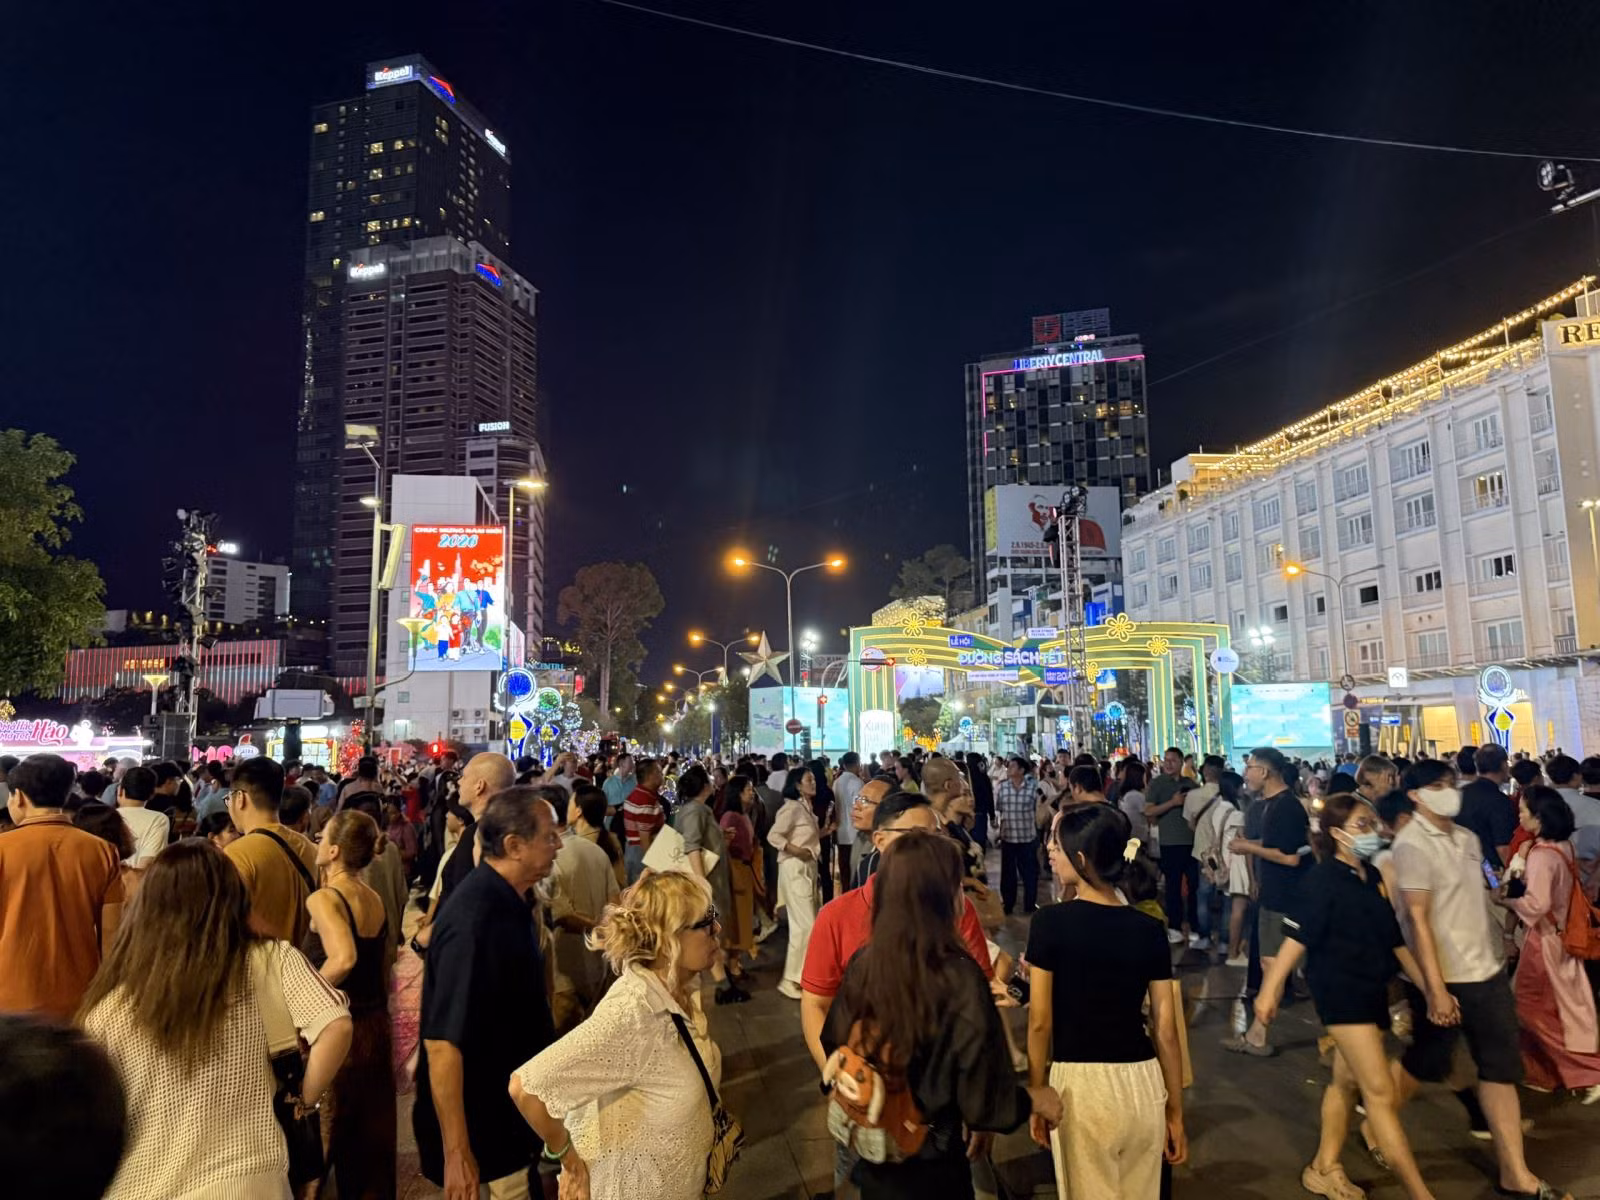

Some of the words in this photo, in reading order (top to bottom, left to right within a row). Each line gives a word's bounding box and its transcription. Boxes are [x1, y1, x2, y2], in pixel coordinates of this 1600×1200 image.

[479, 421, 510, 432] FUSION
[438, 534, 479, 548] 2026
[1004, 648, 1040, 665] SÁCH
[1041, 646, 1064, 664] TẾT
